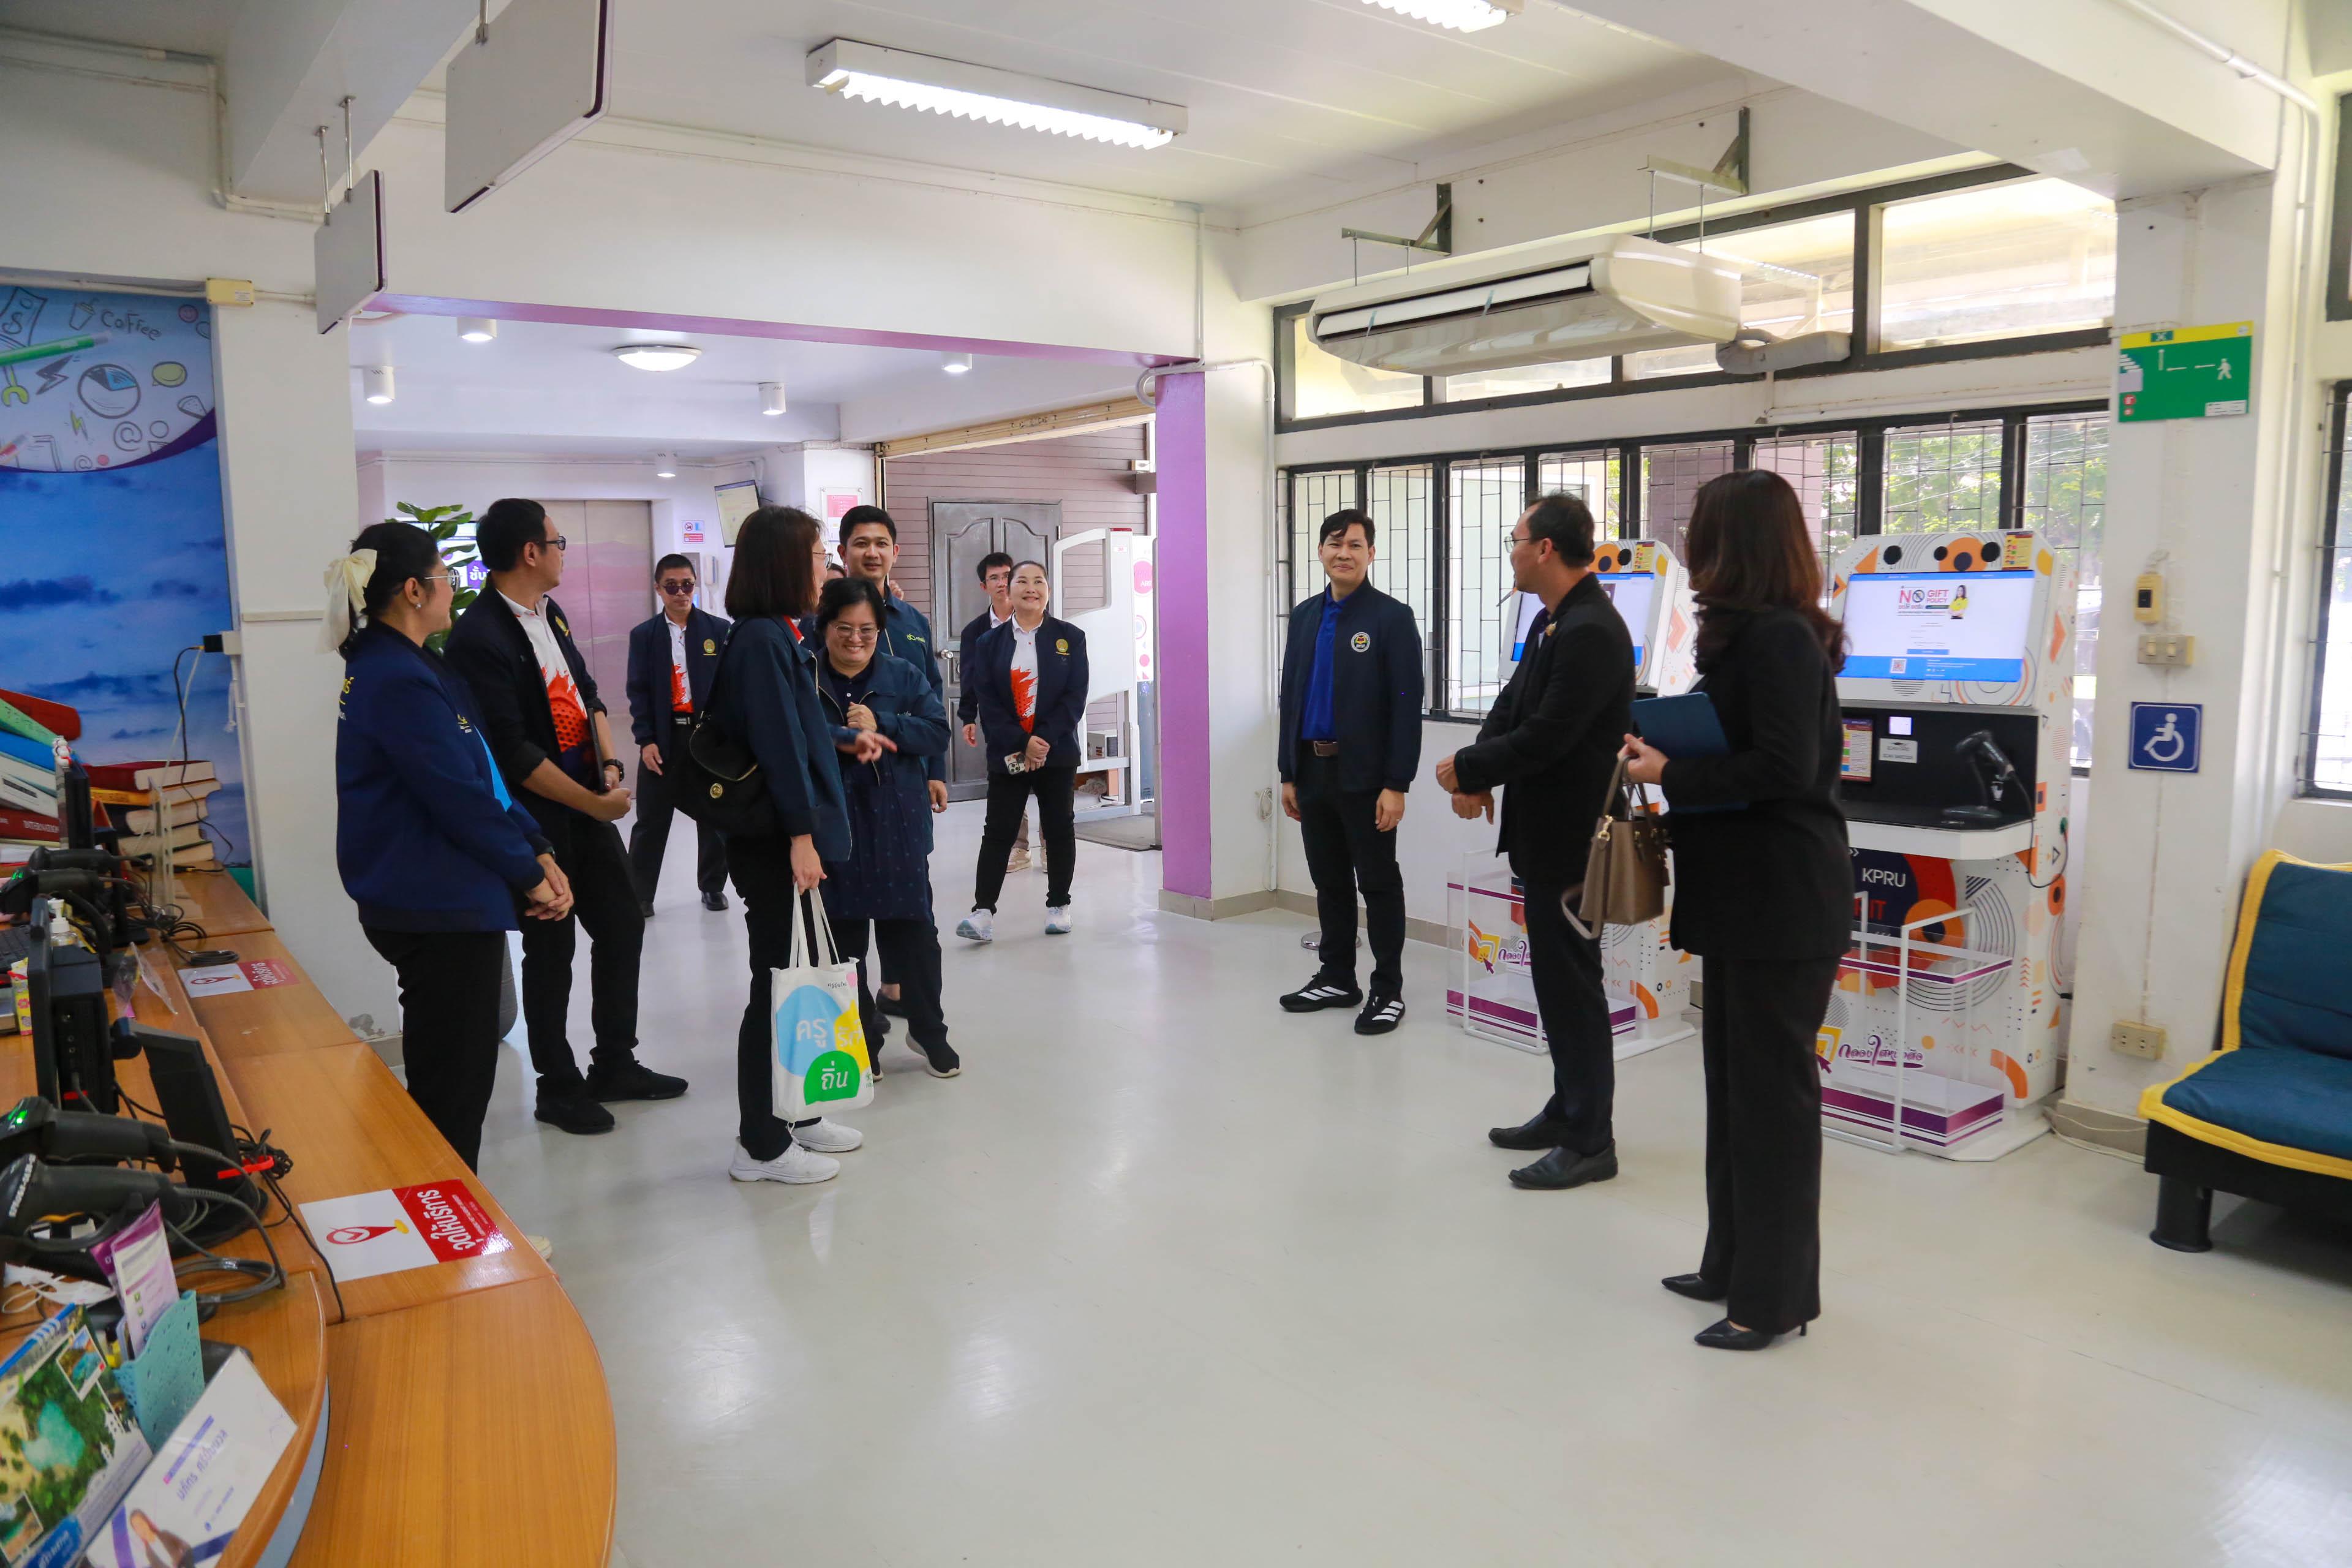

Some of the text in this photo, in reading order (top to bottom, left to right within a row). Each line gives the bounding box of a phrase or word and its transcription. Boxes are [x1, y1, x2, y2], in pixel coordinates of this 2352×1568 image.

[1928, 589, 1950, 598] GIFT
[1862, 867, 1906, 888] KPRU
[796, 1019, 827, 1049] ครู
[821, 1060, 849, 1091] ถิ่น
[417, 1189, 484, 1251] จุดให้บริการ
